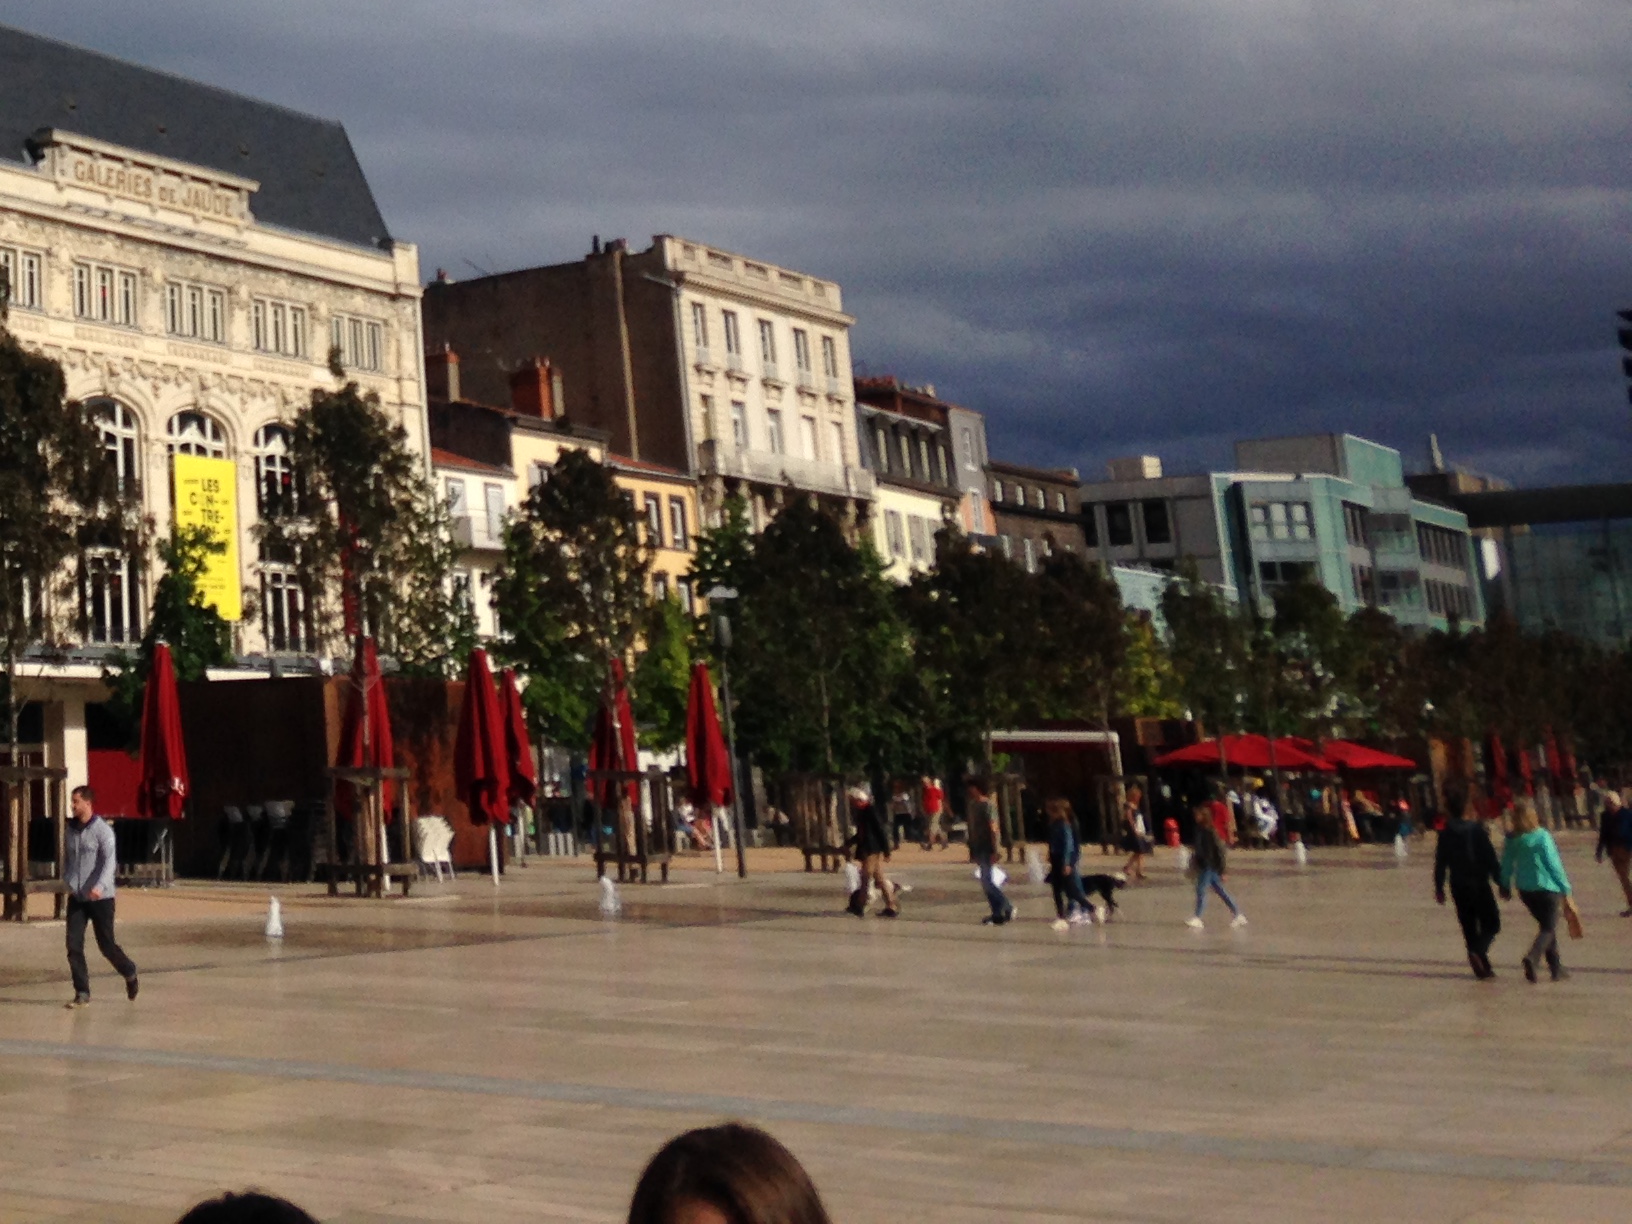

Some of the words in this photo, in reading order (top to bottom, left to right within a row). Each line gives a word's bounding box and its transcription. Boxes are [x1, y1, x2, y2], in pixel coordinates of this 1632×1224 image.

[74, 160, 152, 199] GALERIES
[158, 186, 177, 204] DE
[182, 187, 233, 218] JAUDE
[201, 479, 220, 493] LES
[189, 492, 219, 507] CN-
